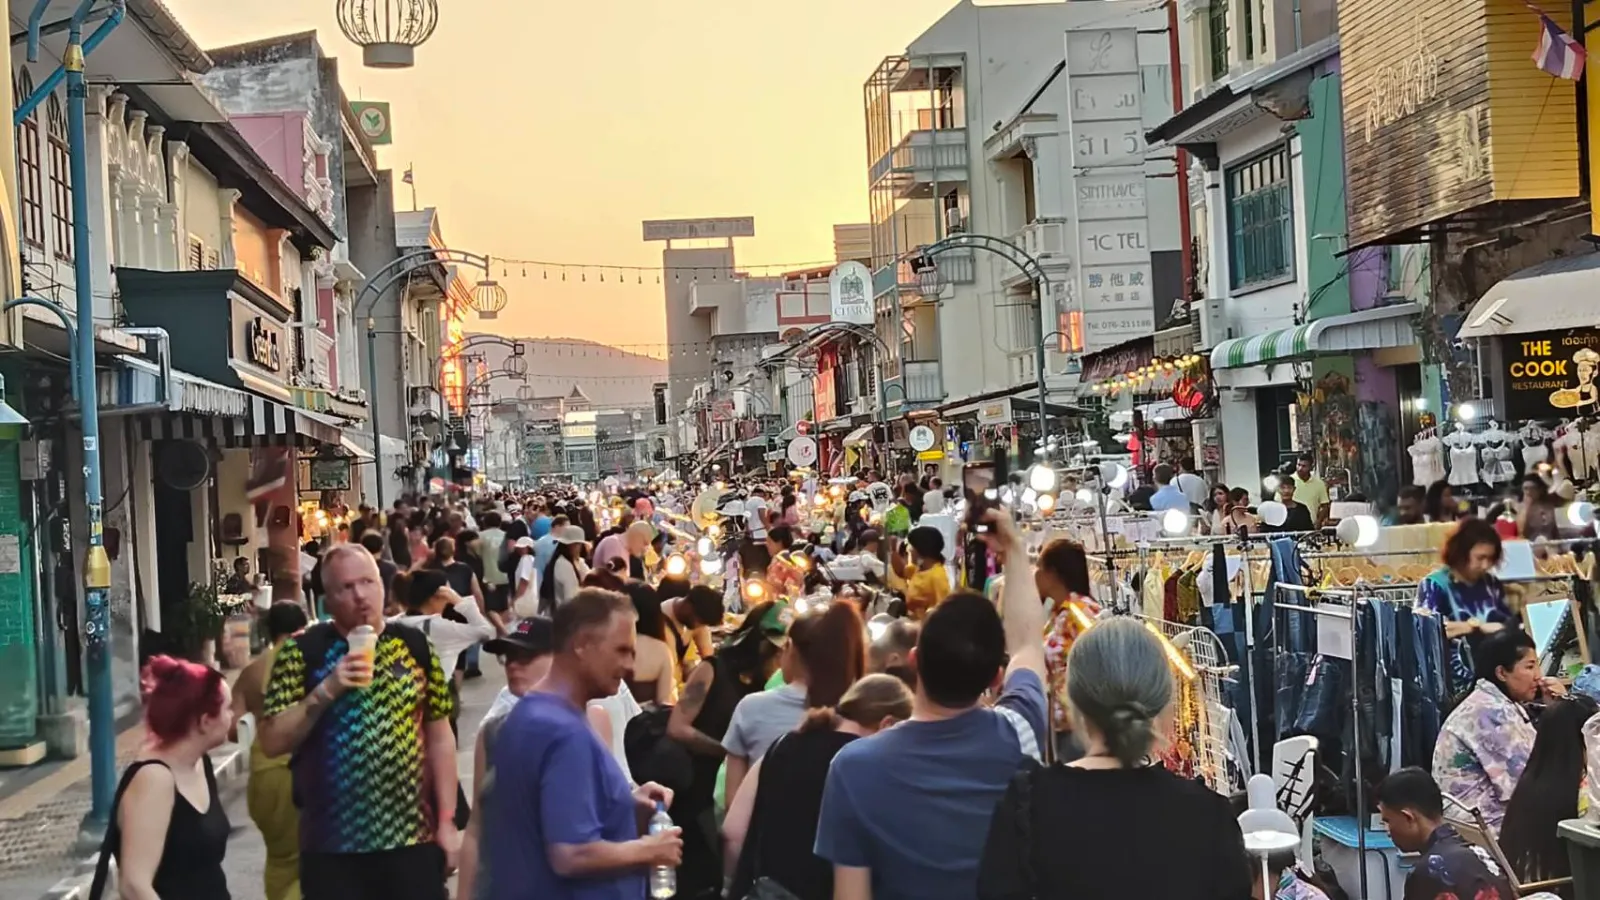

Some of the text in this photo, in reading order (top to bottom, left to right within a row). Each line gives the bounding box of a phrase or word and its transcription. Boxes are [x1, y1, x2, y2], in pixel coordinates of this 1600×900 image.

[1521, 340, 1552, 357] THE
[1510, 360, 1568, 377] COOK
[1512, 380, 1569, 391] RESTAURANT
